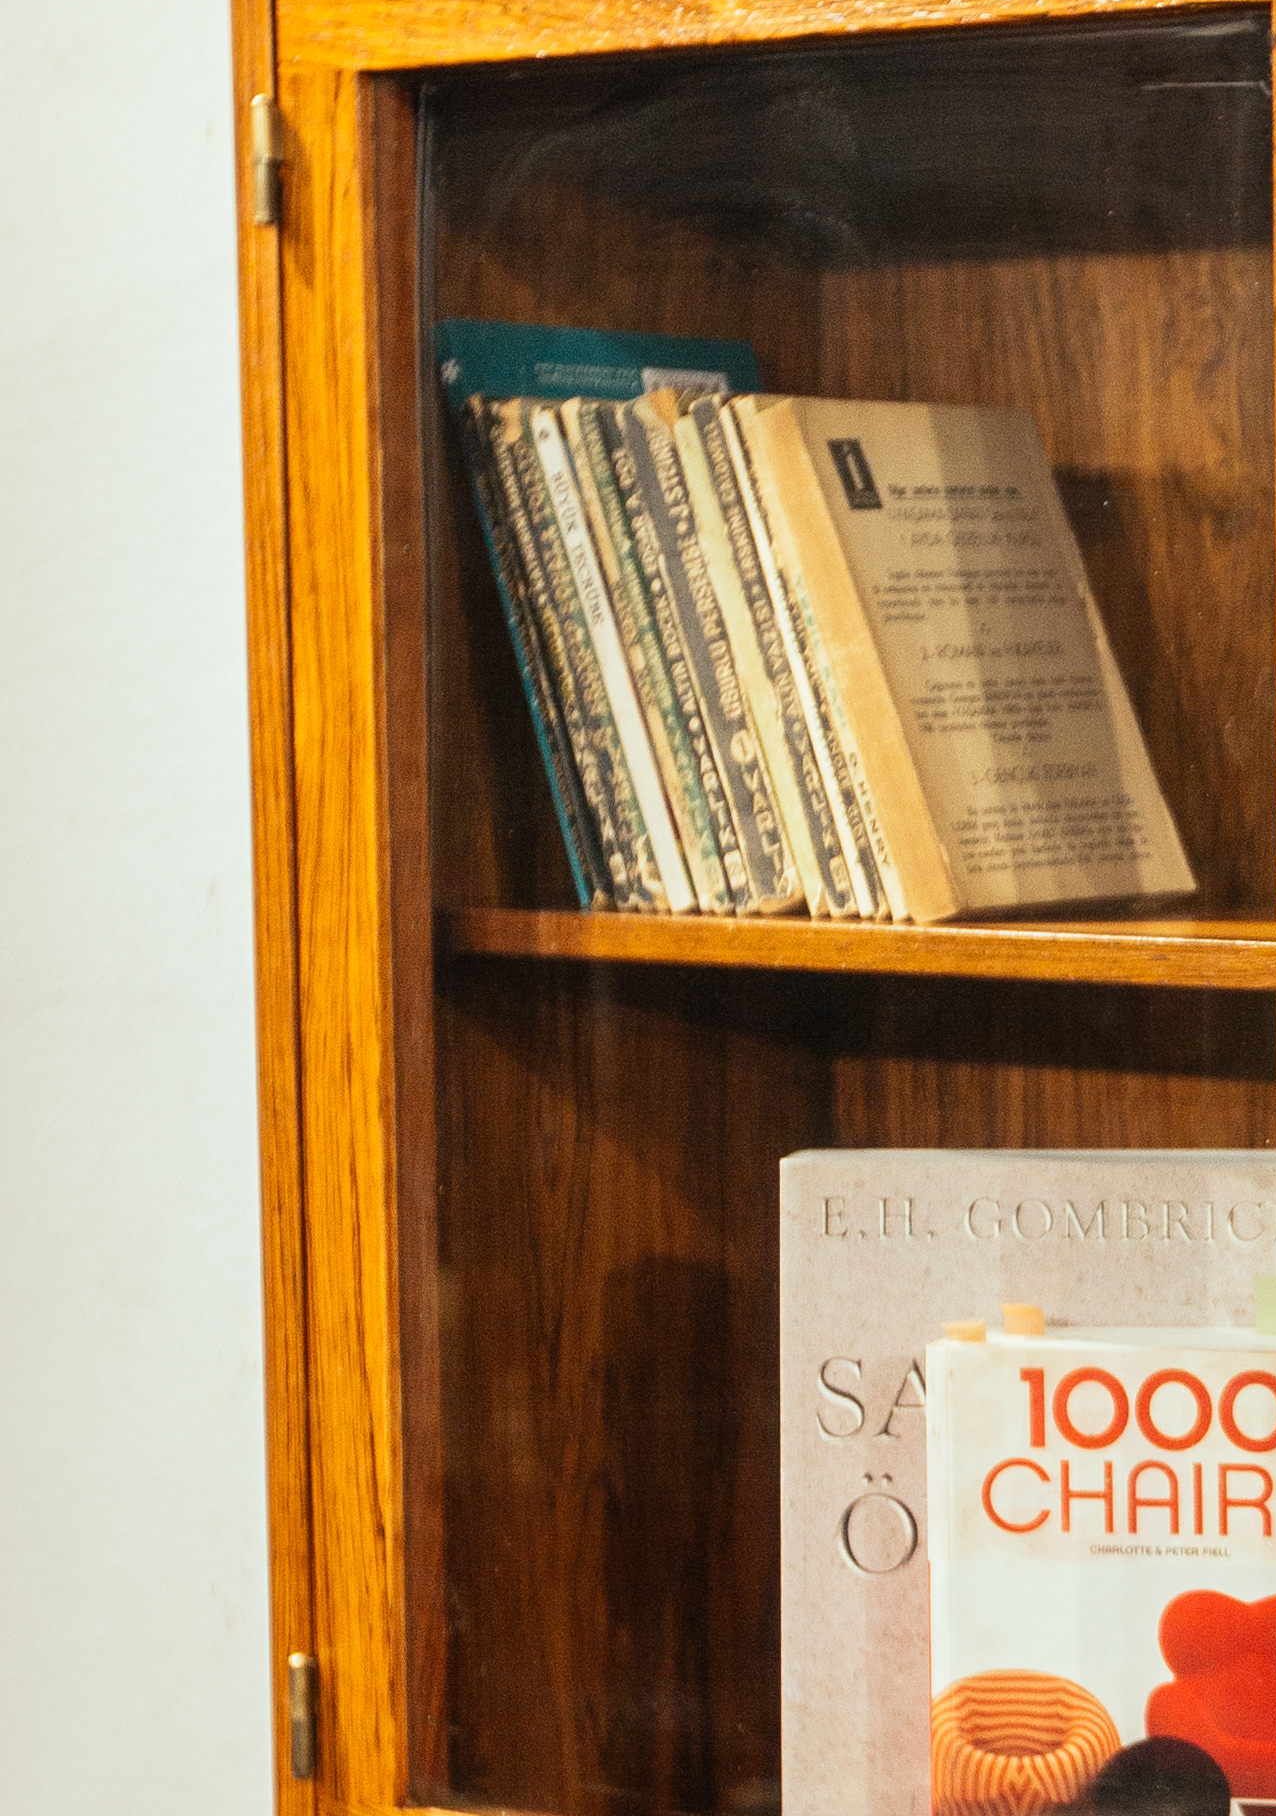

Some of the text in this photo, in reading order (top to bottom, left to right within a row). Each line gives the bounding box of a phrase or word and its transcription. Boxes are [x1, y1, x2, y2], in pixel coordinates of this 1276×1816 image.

[819, 1196, 936, 1240] E.H.
[1089, 1544, 1230, 1558] CHARLOTTE & PETER FIELL
